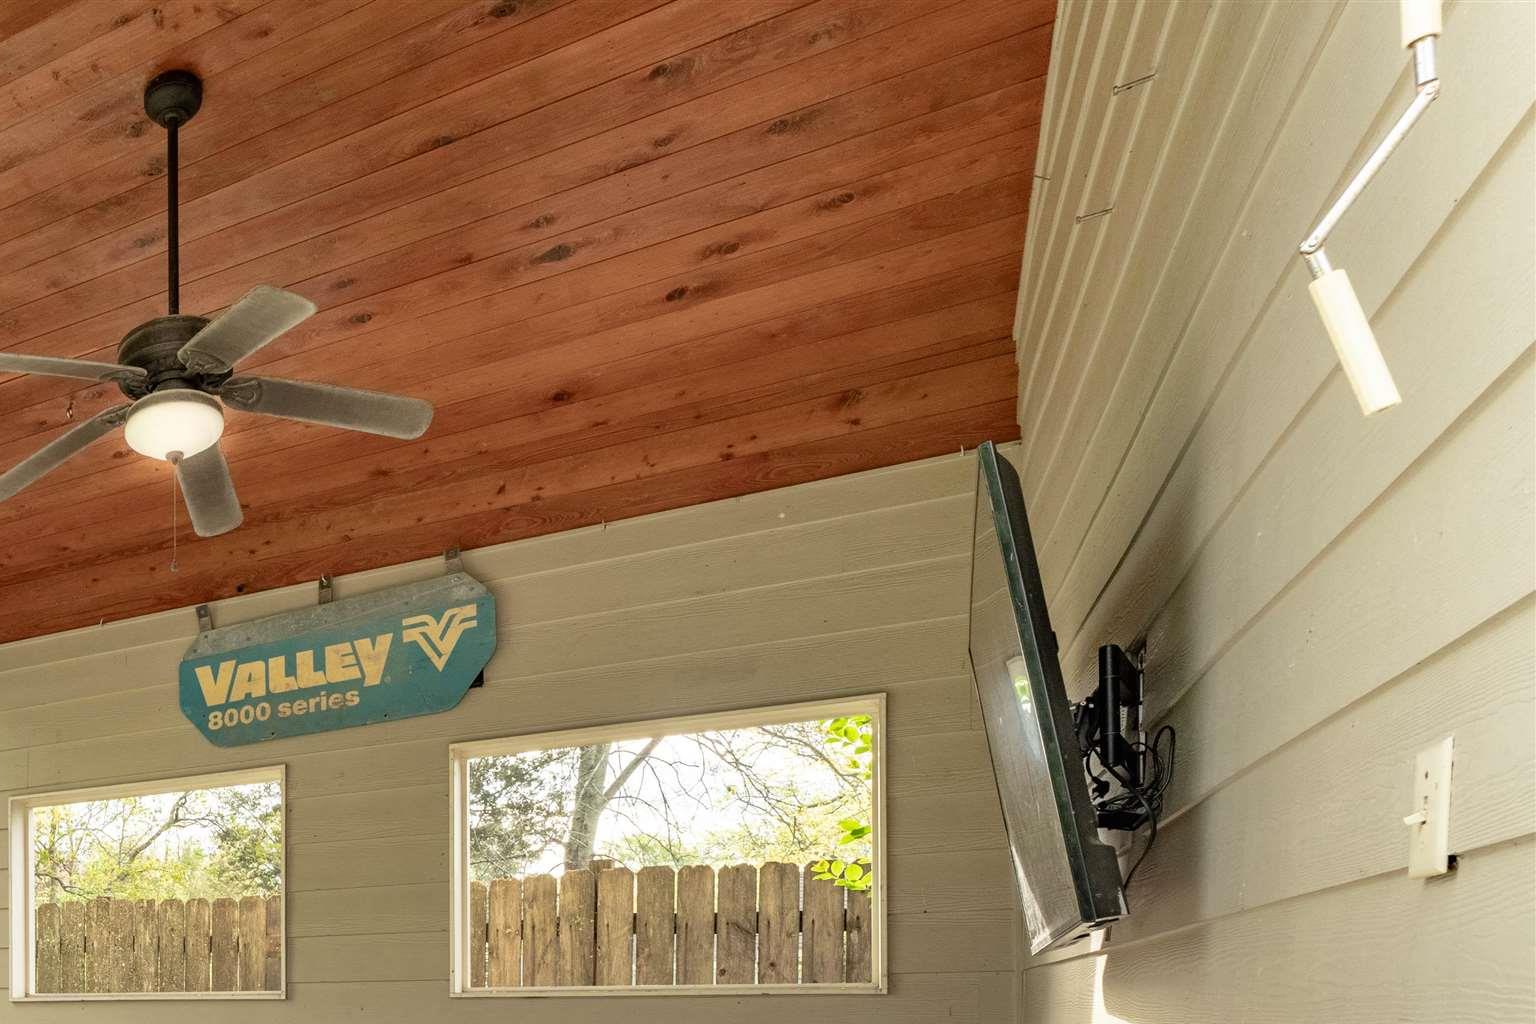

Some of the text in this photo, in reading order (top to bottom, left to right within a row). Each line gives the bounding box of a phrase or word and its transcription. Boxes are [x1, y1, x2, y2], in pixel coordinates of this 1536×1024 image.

[194, 633, 393, 706] VALLEY
[208, 689, 360, 730] 8000 series
